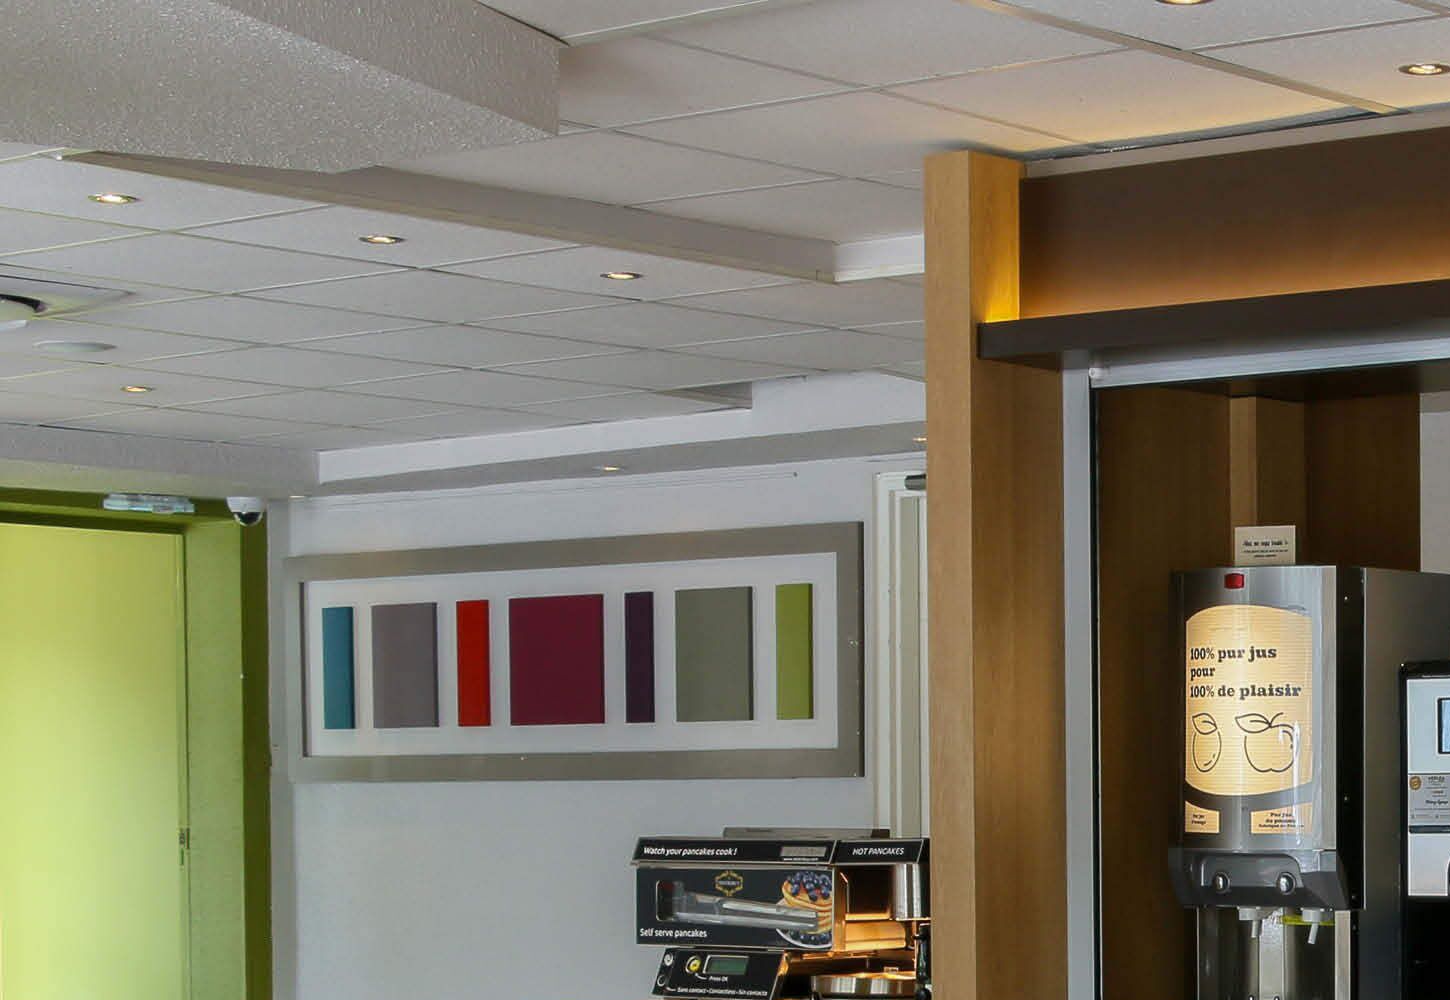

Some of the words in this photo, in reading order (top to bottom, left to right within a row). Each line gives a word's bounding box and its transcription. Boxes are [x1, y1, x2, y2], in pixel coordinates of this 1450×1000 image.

[1190, 647, 1215, 660] 100%
[1218, 648, 1245, 663] pur
[1248, 646, 1277, 662] jus
[1190, 667, 1216, 681] pour
[1190, 685, 1215, 698] 100%
[1217, 685, 1236, 697] de
[1239, 683, 1303, 700] plaisir
[643, 847, 666, 856] Watch
[665, 848, 682, 857] your
[682, 847, 715, 857] pancakes
[715, 847, 733, 856] cook
[852, 847, 868, 856] HOT
[868, 847, 905, 856] PANCAKES
[640, 928, 654, 937] Self
[655, 929, 673, 937] serve
[674, 928, 708, 938] pancakes
